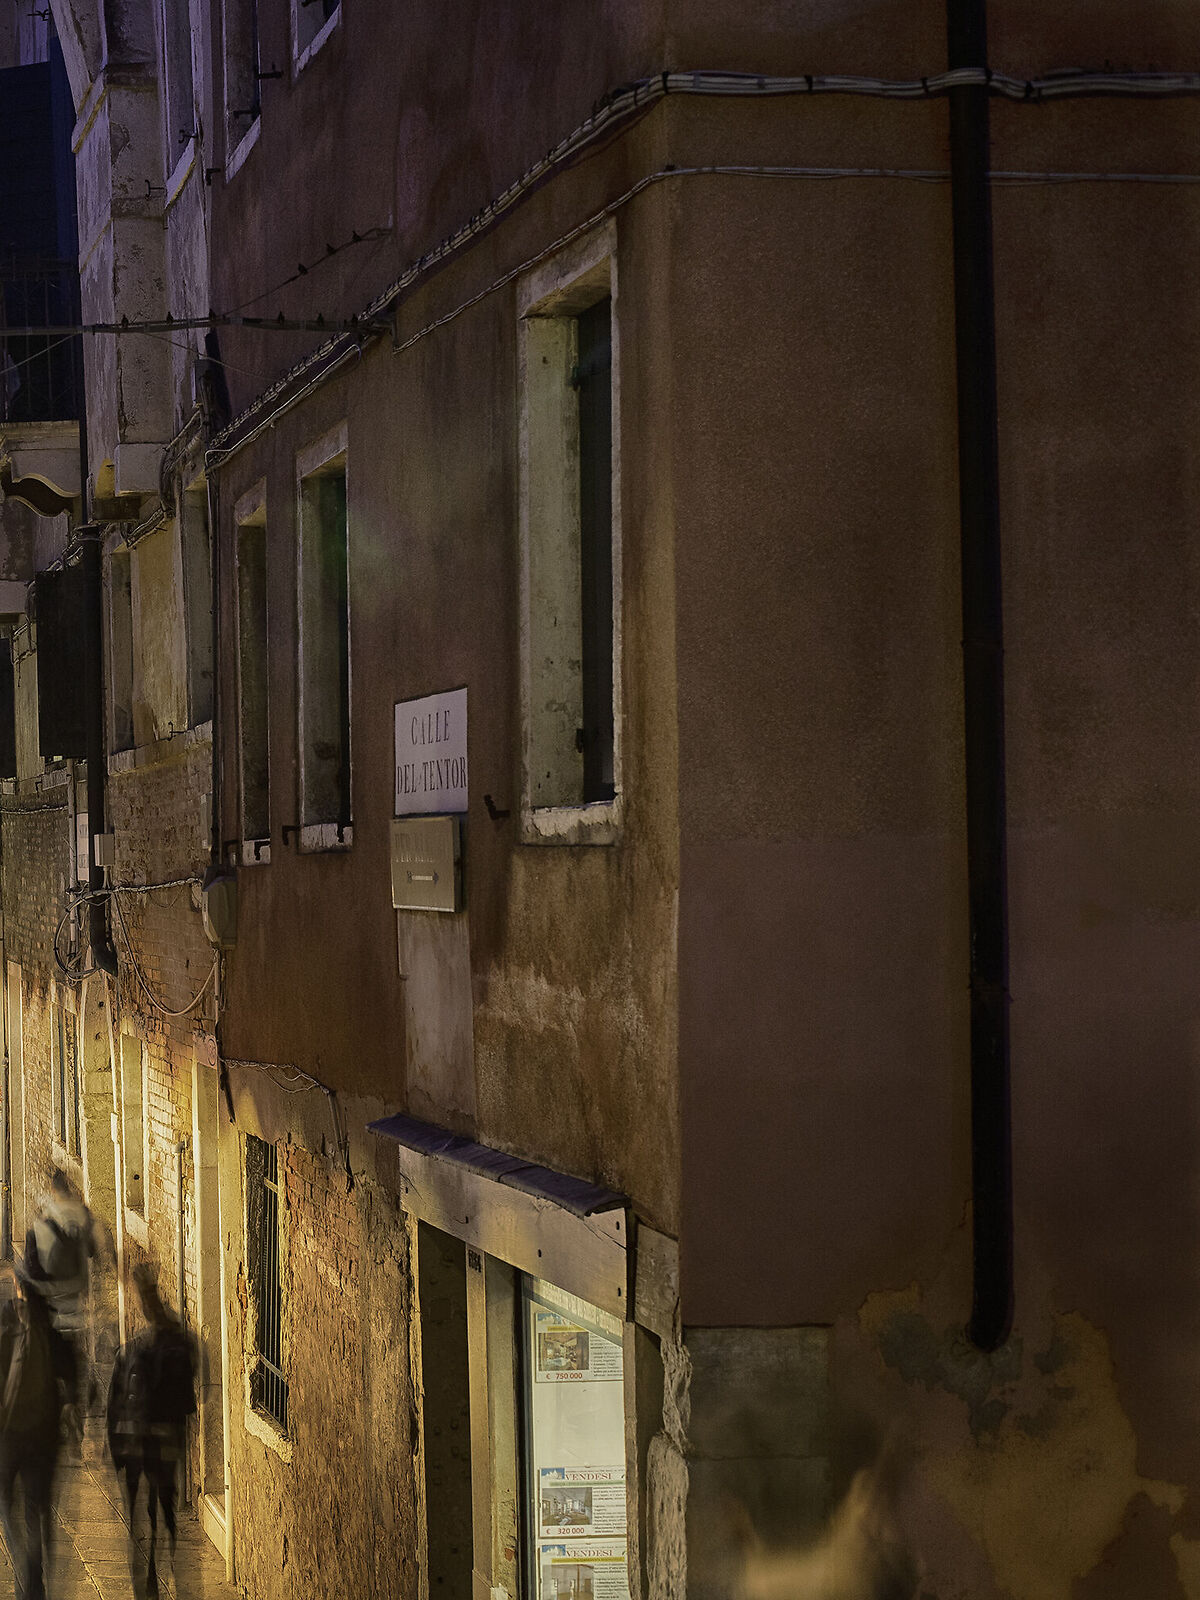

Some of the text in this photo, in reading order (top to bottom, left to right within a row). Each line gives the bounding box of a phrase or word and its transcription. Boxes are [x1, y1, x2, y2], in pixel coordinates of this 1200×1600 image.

[411, 710, 450, 745] CALLE
[397, 757, 467, 794] DEL TENTOR
[565, 1472, 612, 1480] VENDESI
[566, 1549, 612, 1557] VENDESI
